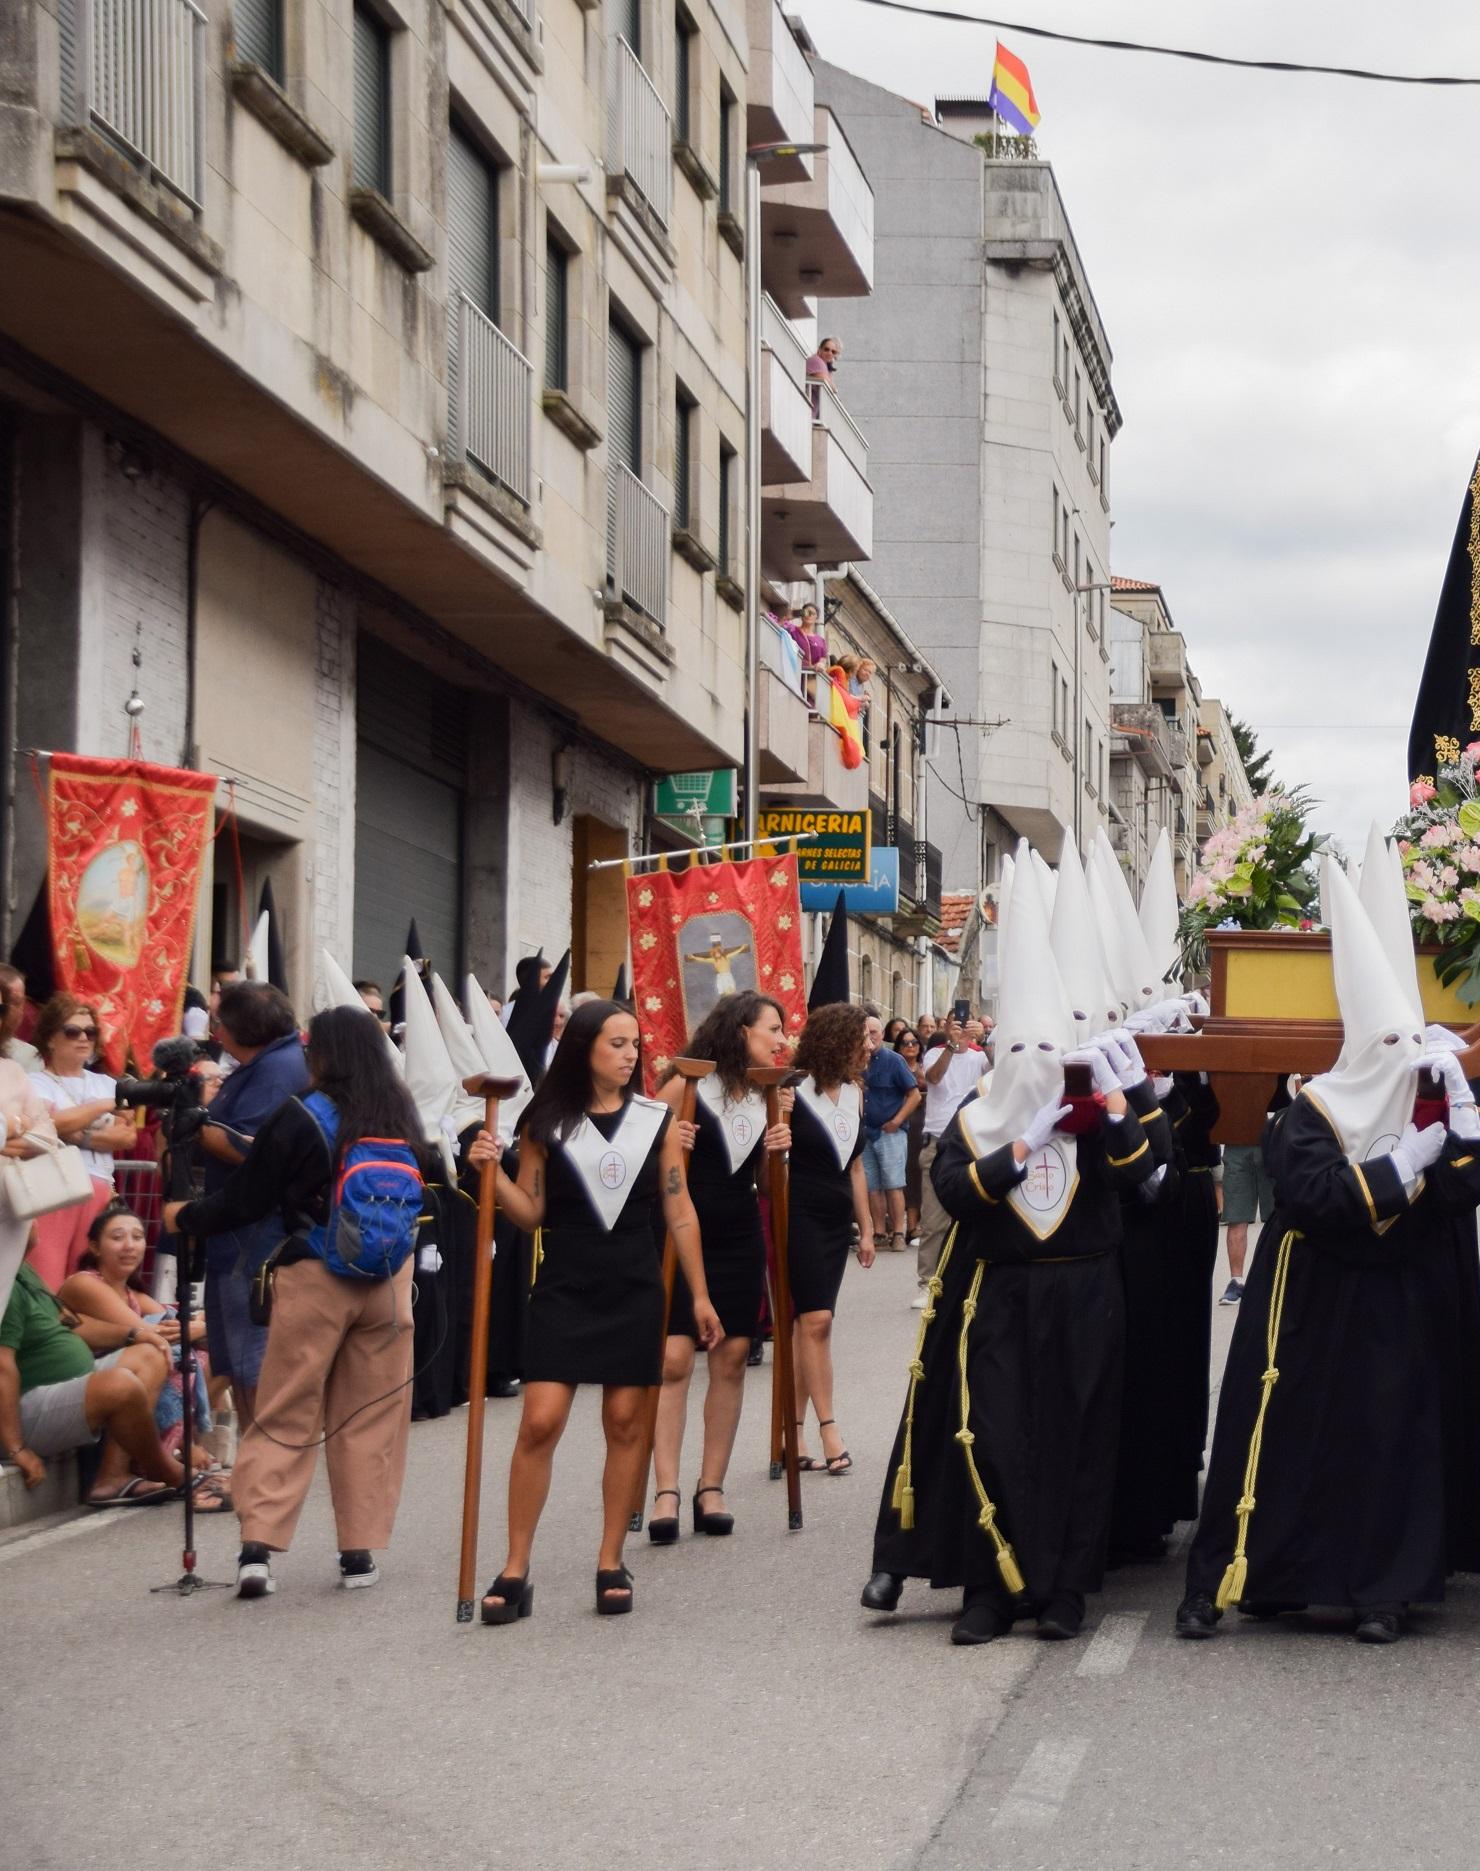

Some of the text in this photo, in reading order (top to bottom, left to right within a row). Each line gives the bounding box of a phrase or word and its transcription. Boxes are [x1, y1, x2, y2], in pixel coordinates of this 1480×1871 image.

[739, 813, 862, 834] ARNICERIA
[824, 848, 862, 858] SELECTAS
[804, 861, 861, 871] DE GALICIA
